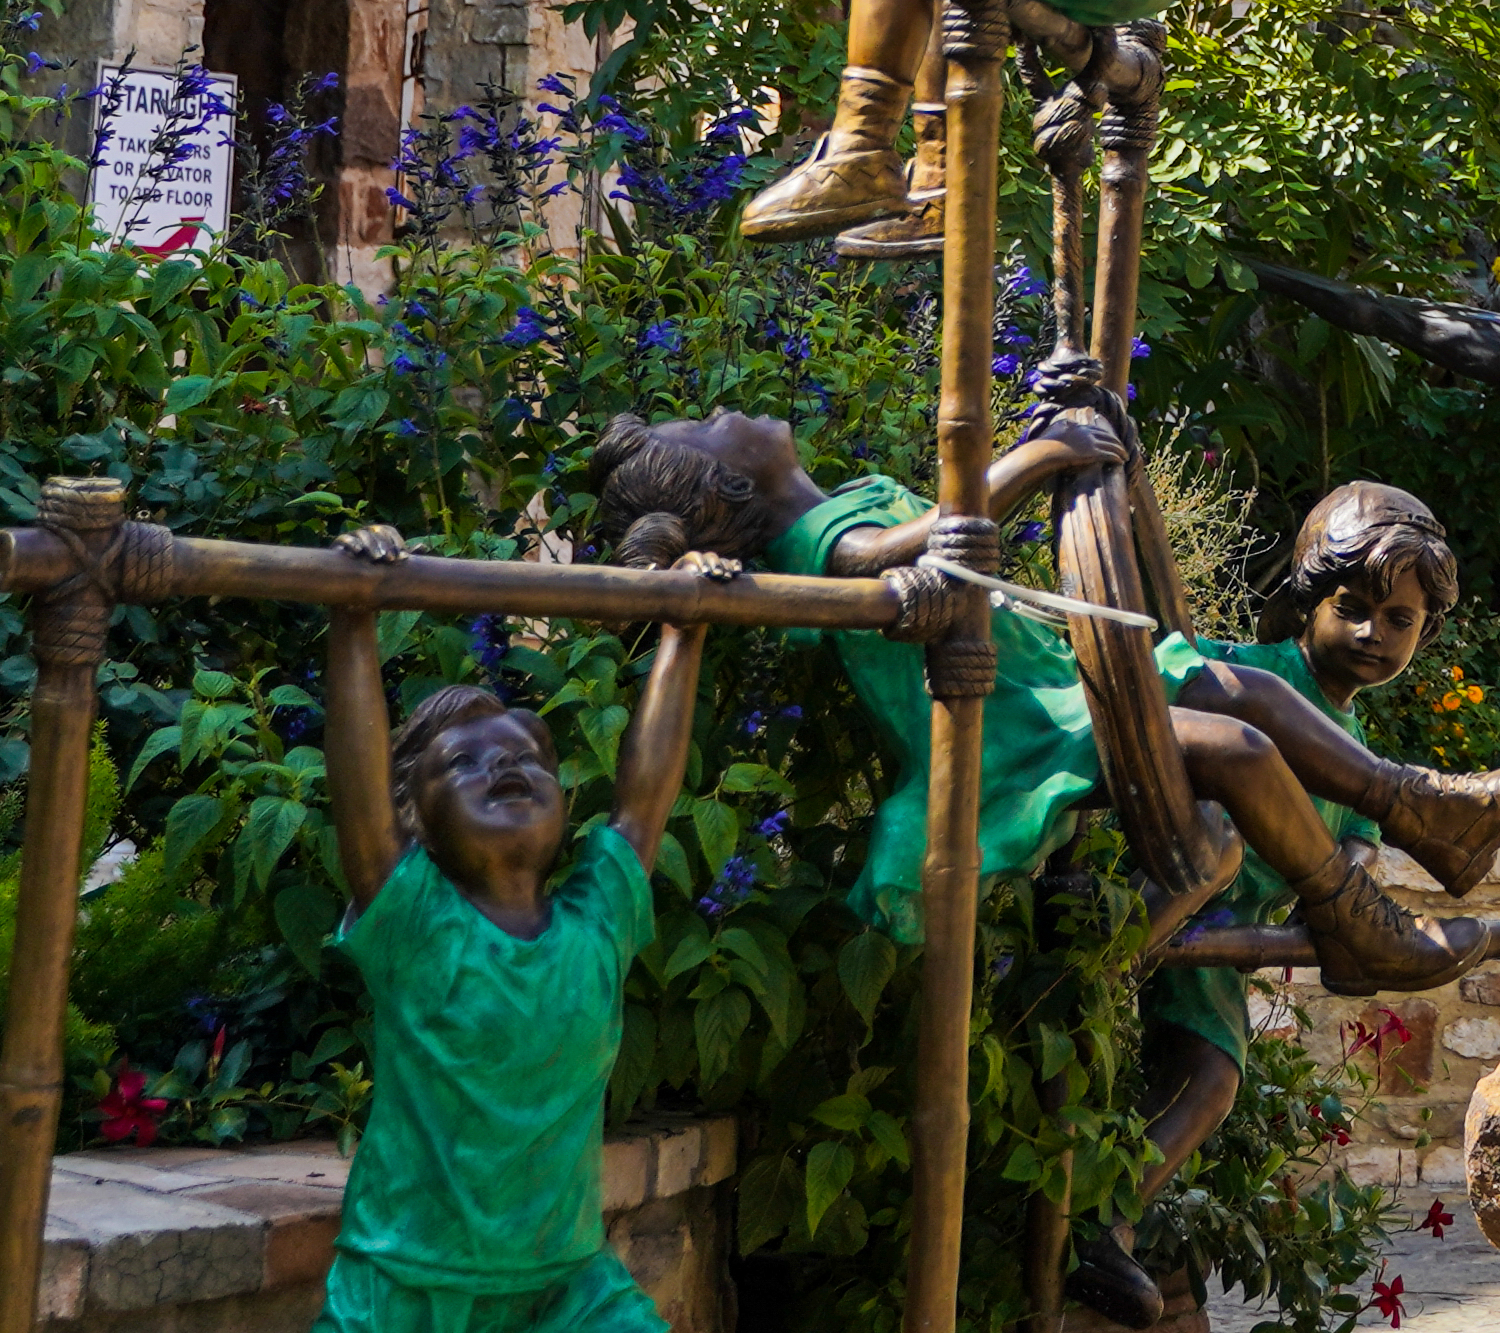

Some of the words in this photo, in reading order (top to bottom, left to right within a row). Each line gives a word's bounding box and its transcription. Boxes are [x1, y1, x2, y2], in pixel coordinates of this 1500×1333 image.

[113, 161, 134, 176] OR
[109, 185, 128, 200] TO
[166, 190, 213, 208] FLOOR
